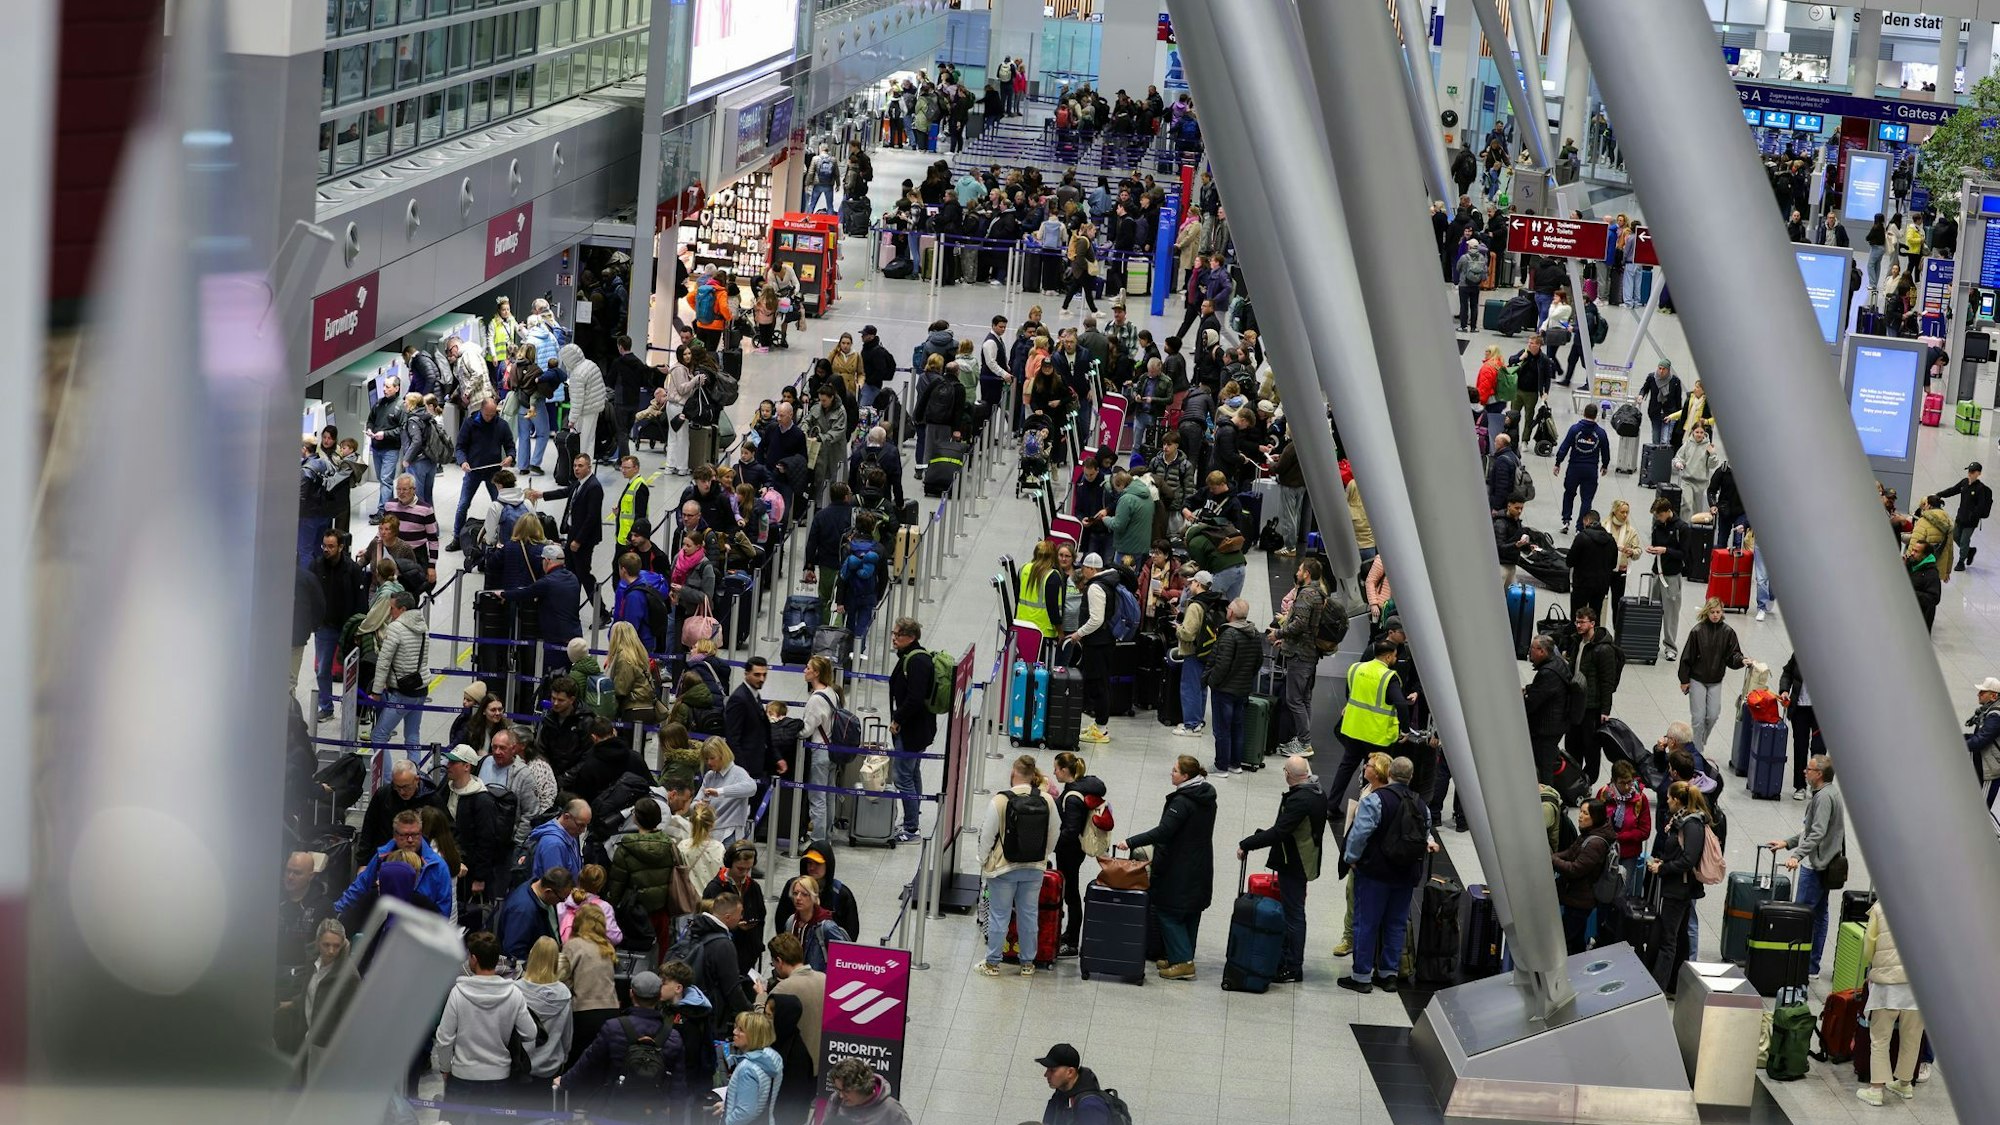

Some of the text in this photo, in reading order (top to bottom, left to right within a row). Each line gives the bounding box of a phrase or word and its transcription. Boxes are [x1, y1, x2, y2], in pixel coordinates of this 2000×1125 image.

[1751, 89, 1761, 101] A
[1769, 92, 1787, 100] Zugang
[1898, 105, 1950, 122] Gates A
[1557, 221, 1581, 230] Toiletten
[1542, 241, 1556, 250] Baby
[1543, 235, 1576, 244] Wickelraum
[325, 309, 358, 342] Eurowings
[835, 958, 886, 975] Eurowings
[829, 1040, 892, 1058] PRIORITY-
[828, 1053, 889, 1071] CHK-IN
